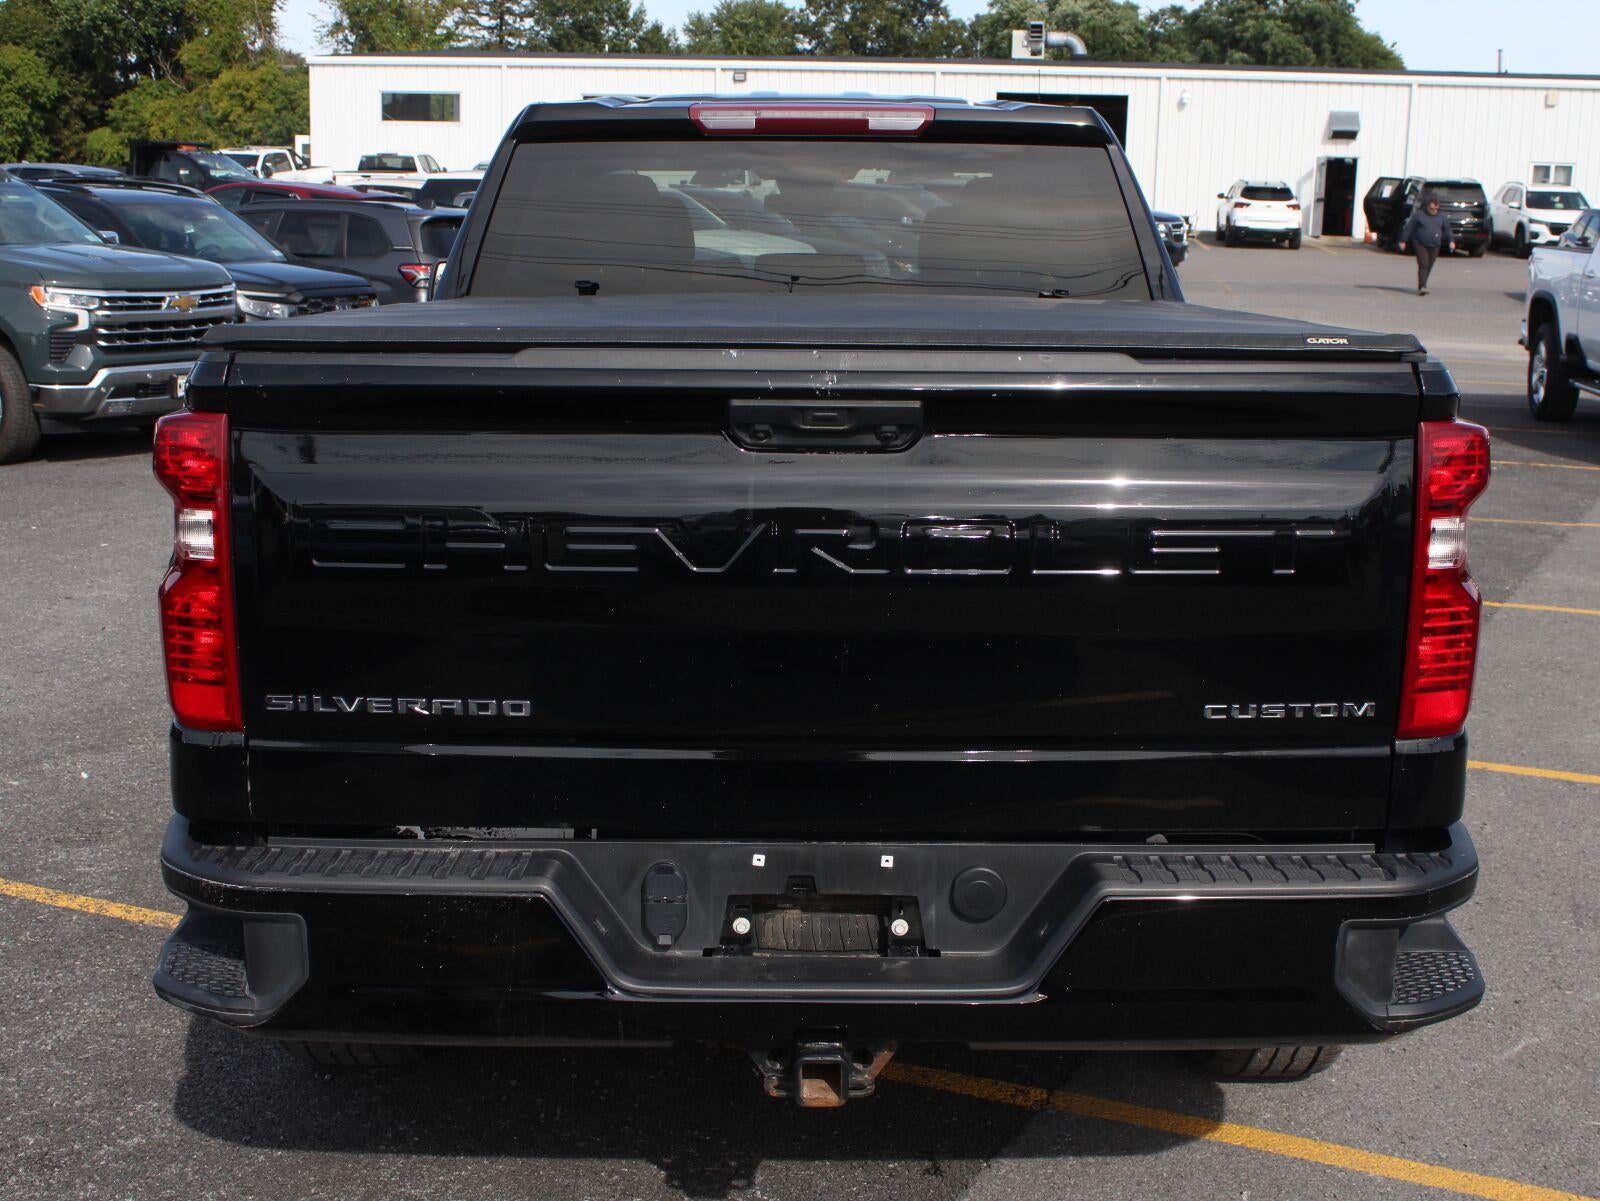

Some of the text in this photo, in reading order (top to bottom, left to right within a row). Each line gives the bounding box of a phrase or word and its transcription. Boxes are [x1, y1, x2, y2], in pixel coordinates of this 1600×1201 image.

[1306, 337, 1349, 345] GATOR
[309, 514, 1338, 577] CHEVROLET
[265, 694, 532, 717] SILVERADO
[1203, 702, 1376, 719] CUSTOM
